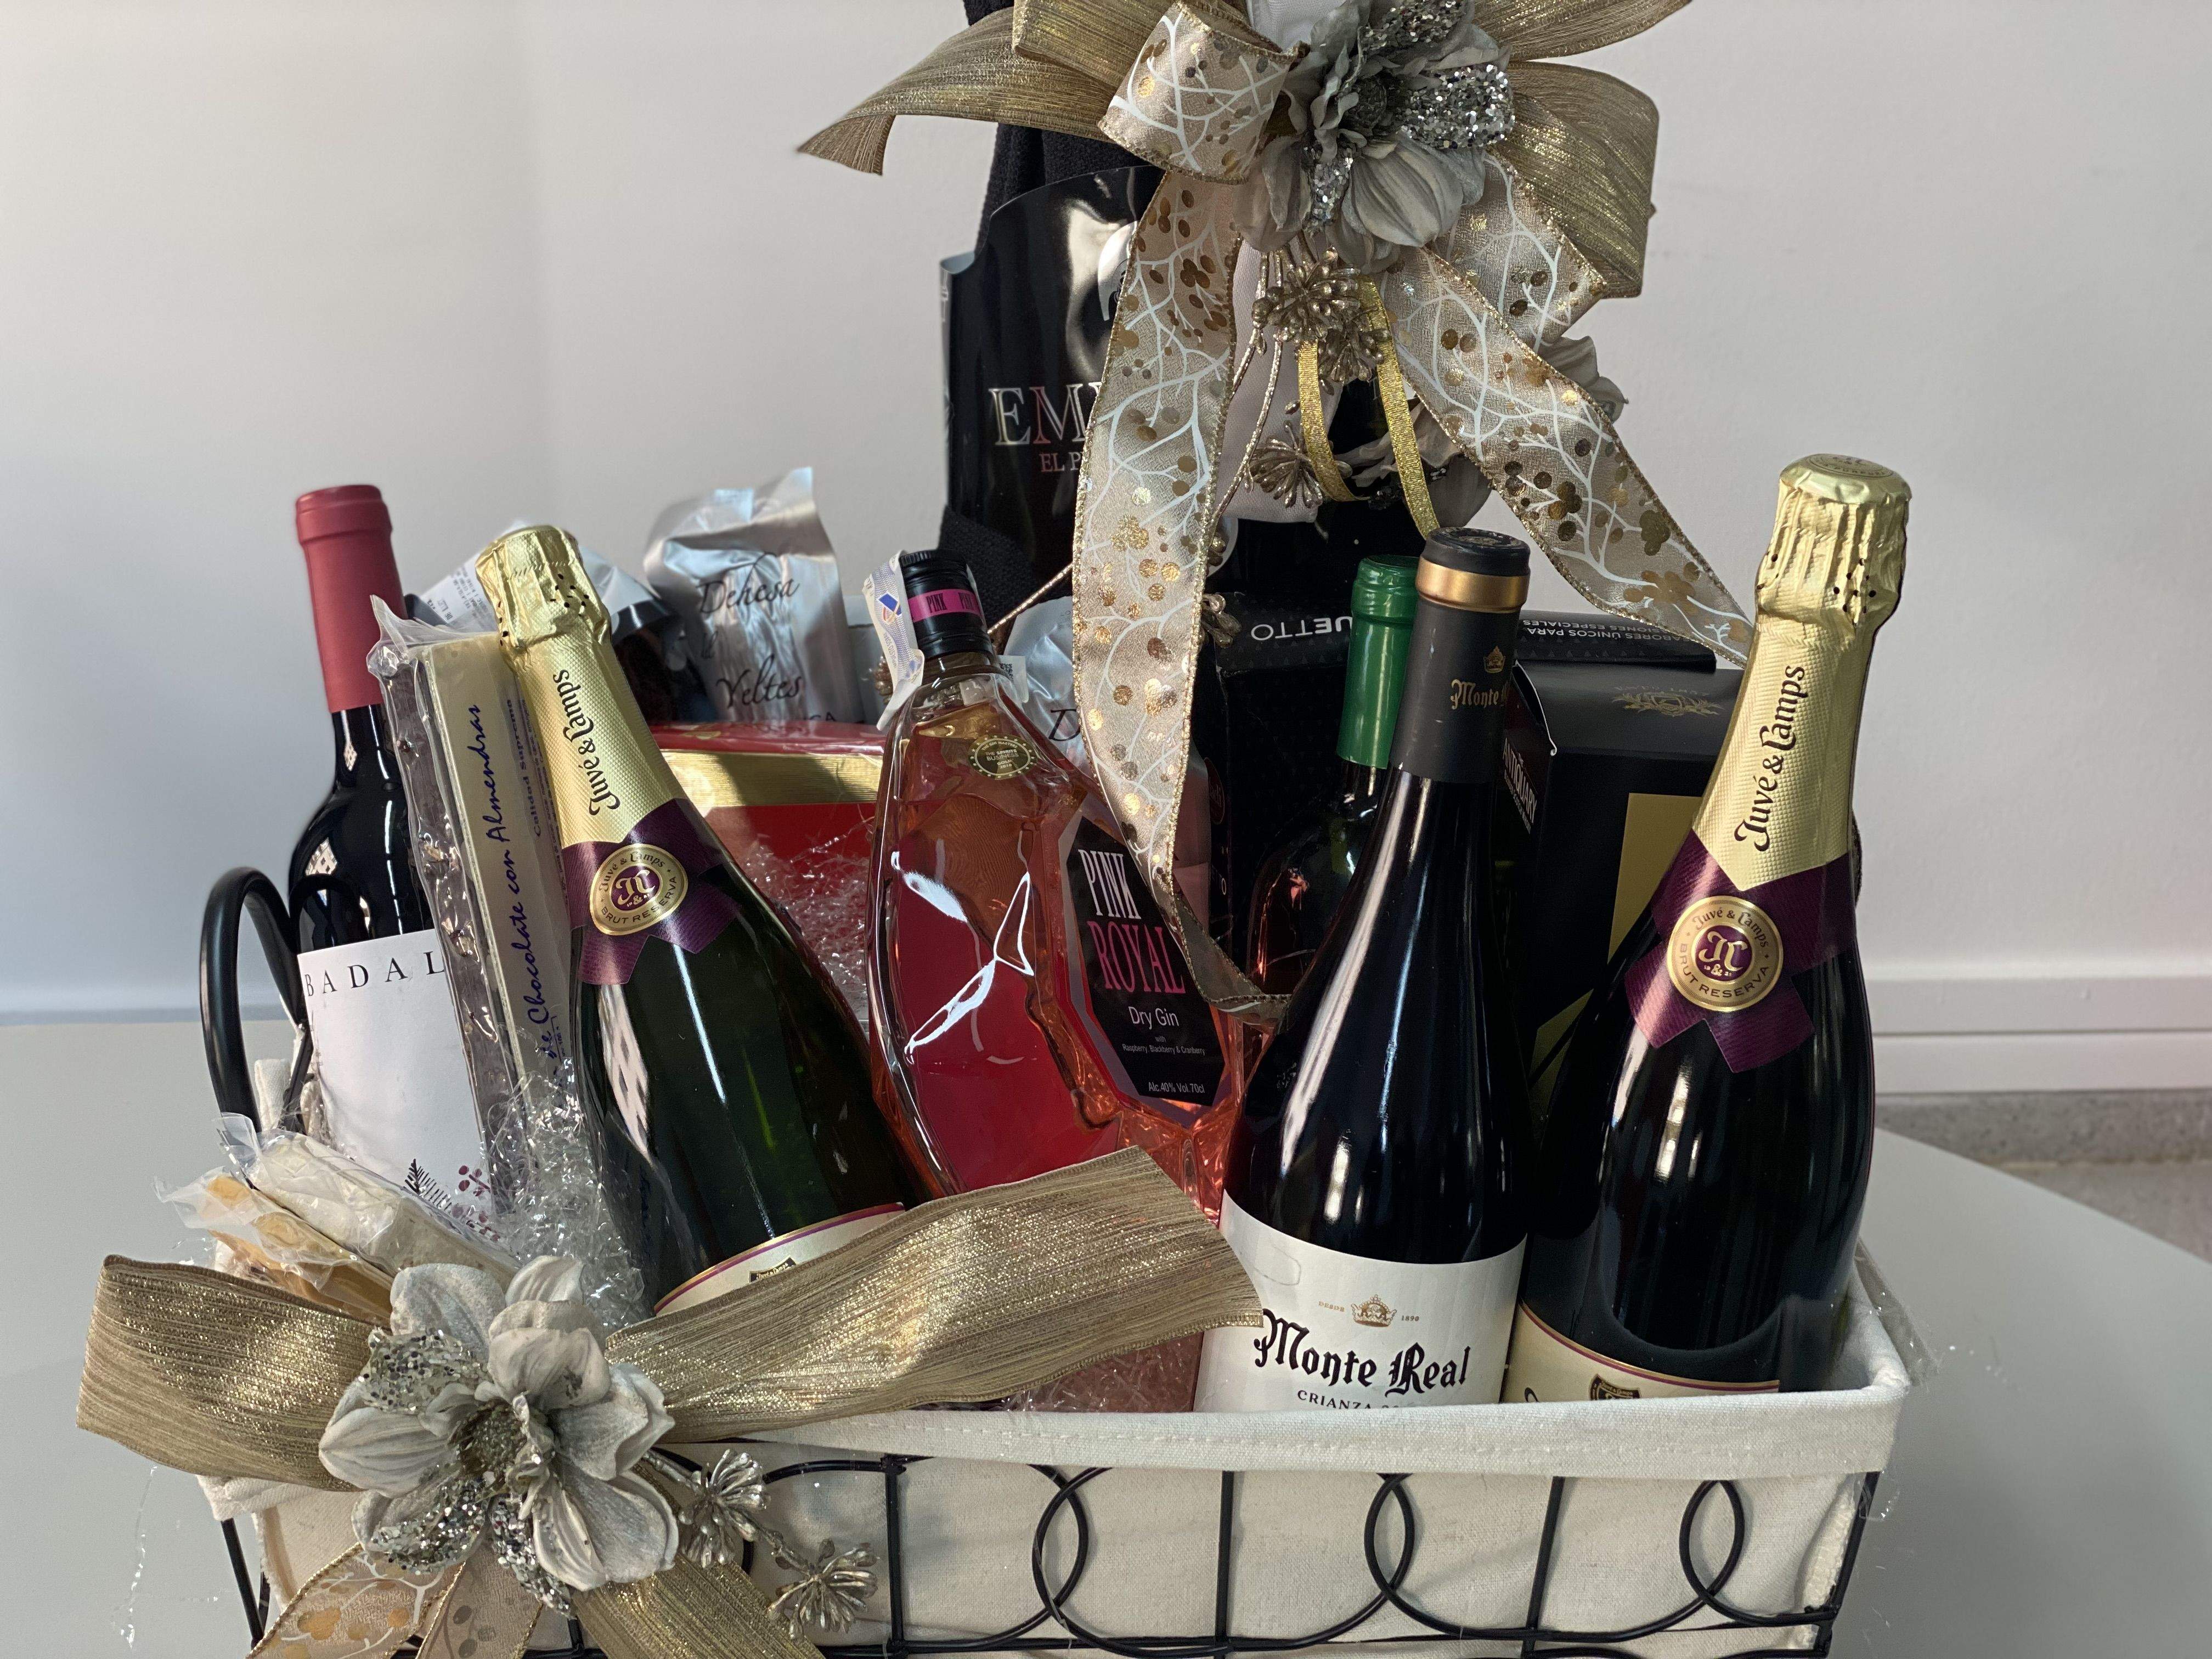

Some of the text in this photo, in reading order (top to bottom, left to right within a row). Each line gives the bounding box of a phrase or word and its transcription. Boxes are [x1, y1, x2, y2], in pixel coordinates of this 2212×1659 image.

[988, 382, 1103, 445] EM
[1039, 453, 1065, 472] EL
[696, 551, 800, 613] Dehesa
[926, 592, 948, 614] PINK
[1522, 619, 1606, 630] ESPECIALES
[1527, 627, 1565, 636] PARA
[1569, 630, 1621, 640] ÚNICOS
[1450, 679, 1499, 710] Monte
[552, 669, 621, 816] Juvé & Camps
[1734, 665, 1808, 852] Juvé & Camps
[467, 704, 511, 842] Almendras
[522, 776, 542, 838] Calidad
[503, 849, 521, 895] con
[620, 857, 628, 866] &
[1077, 849, 1142, 919] PINK
[601, 876, 677, 924] BRUT RESERVA
[1692, 906, 1769, 948] Juvé & Camps
[509, 901, 550, 1024] Chocolate
[1086, 921, 1186, 994] ROYAL
[1679, 943, 1770, 998] BRUT RESERVA
[1128, 1006, 1180, 1030] Dry Gin
[1149, 1045, 1175, 1055] Blackberry
[1181, 1046, 1205, 1056] Cranberry
[1254, 1308, 1471, 1397] Monte Real
